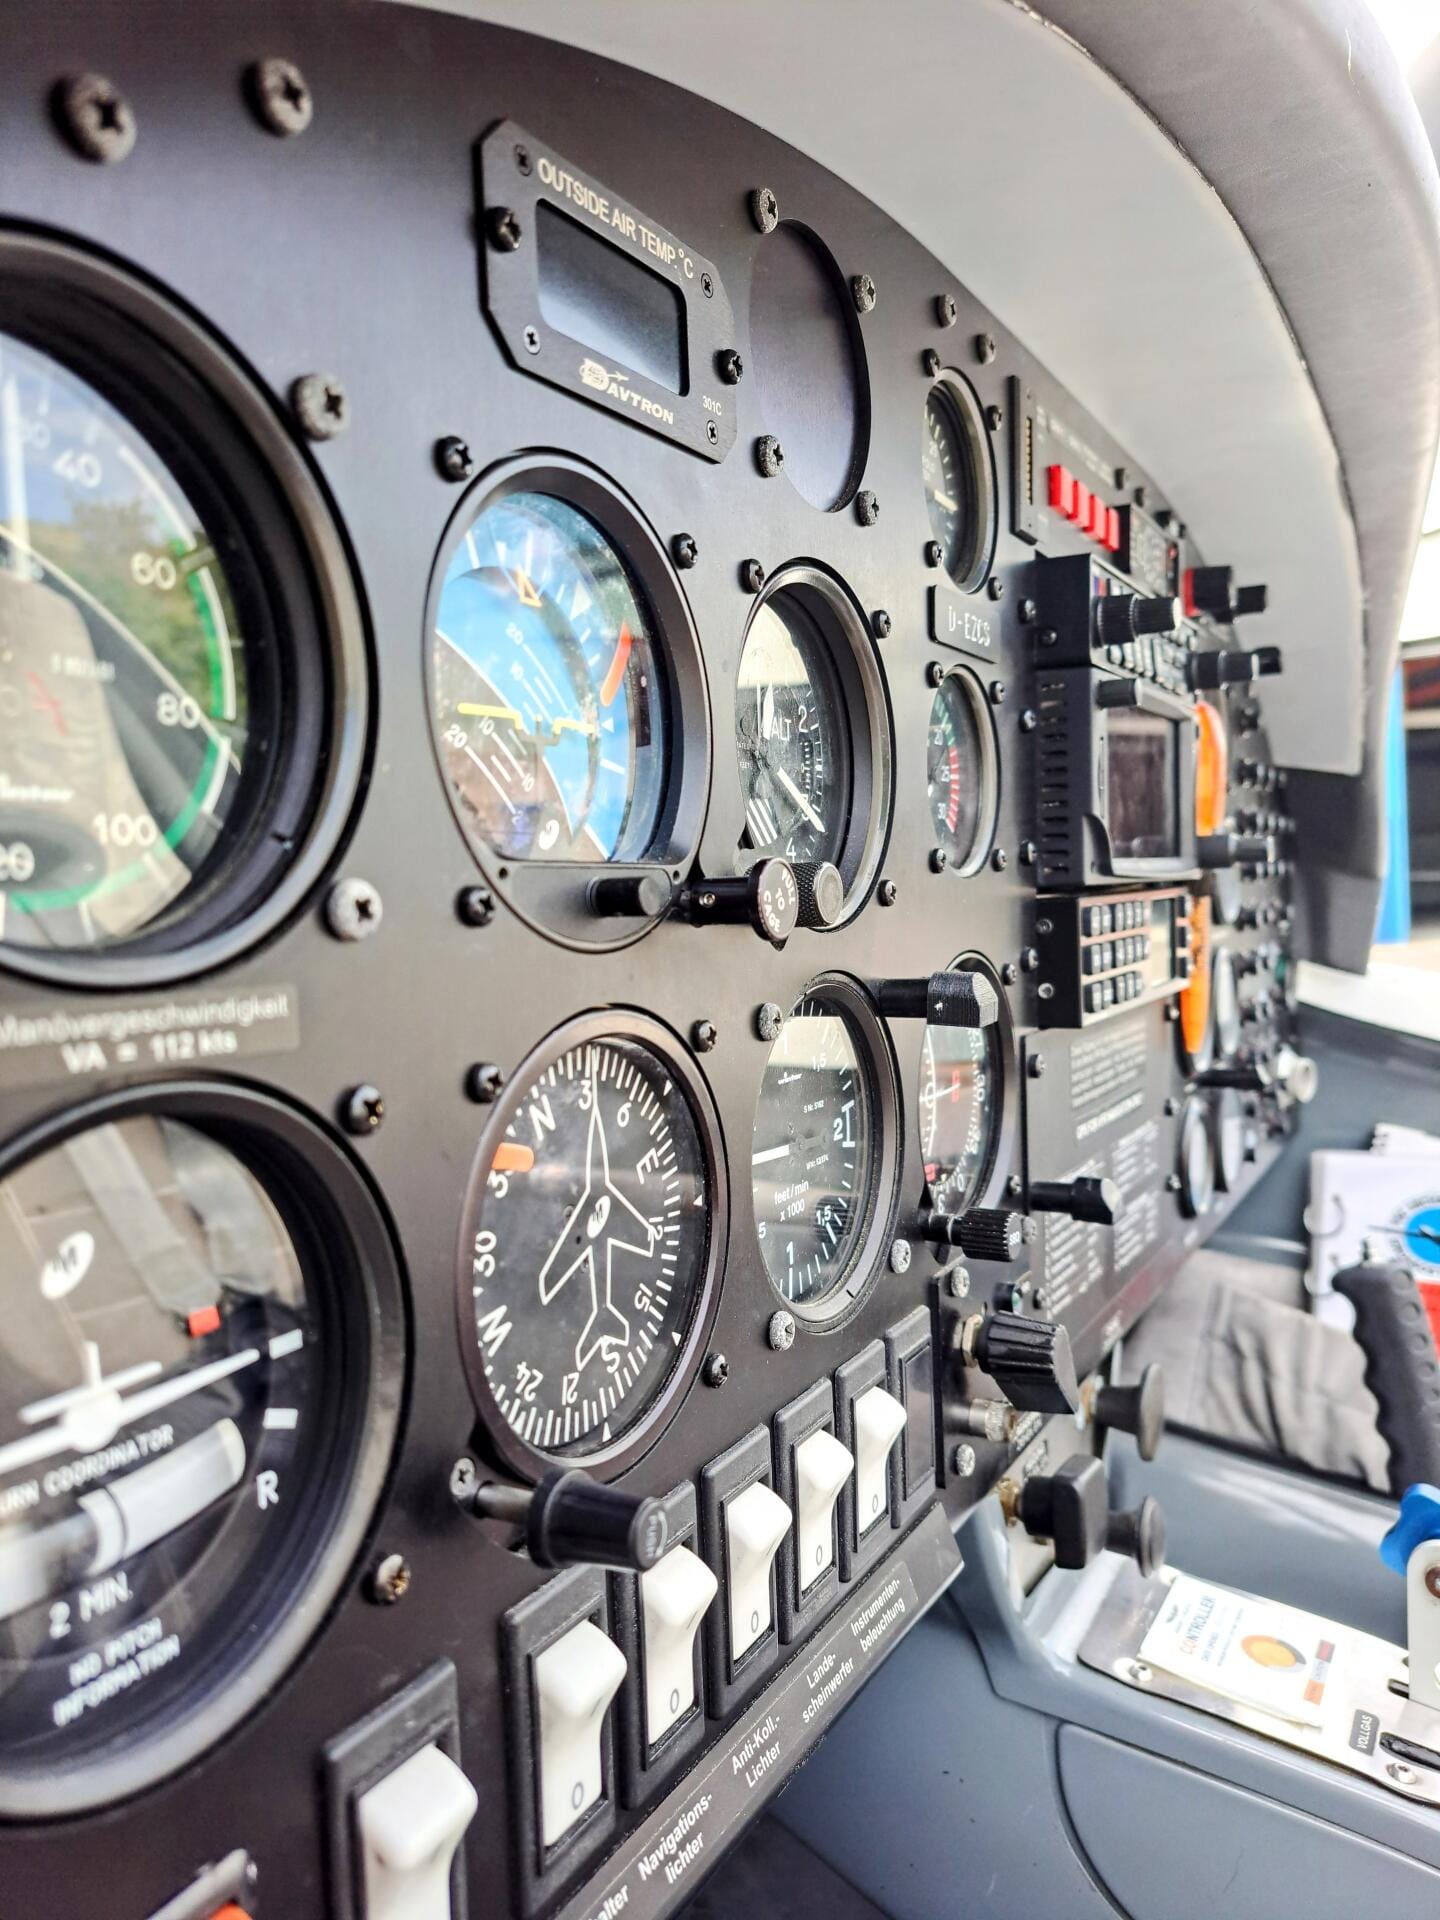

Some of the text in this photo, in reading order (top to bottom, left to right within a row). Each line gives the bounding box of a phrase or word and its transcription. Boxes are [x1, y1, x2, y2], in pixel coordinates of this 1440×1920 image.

[537, 158, 610, 224] OUTSIDE
[611, 208, 637, 242] AIR
[702, 395, 722, 416] 301C
[53, 449, 102, 488] 40
[131, 552, 176, 590] 60
[157, 692, 200, 729] 80
[479, 716, 494, 736] 10
[771, 716, 792, 741] ALT
[798, 705, 809, 733] 2
[444, 724, 469, 750] 20
[93, 812, 157, 847] 100
[786, 837, 797, 863] 4
[775, 887, 785, 911] TO
[781, 868, 795, 905] PULL
[764, 890, 780, 933] CAGE
[578, 1079, 592, 1110] 3
[529, 1094, 557, 1141] N
[617, 1101, 632, 1128] 6
[833, 1118, 844, 1141] 2
[636, 1147, 659, 1184] E
[774, 1180, 809, 1205] feet/min
[787, 1199, 805, 1218] 1000
[816, 1205, 831, 1226] 1,5
[473, 1230, 498, 1278] 30
[786, 1241, 794, 1264] 1
[477, 1304, 512, 1357] W
[515, 1361, 544, 1401] 24
[561, 1371, 580, 1405] 21
[44, 1424, 174, 1497] COORDINATOR
[256, 1470, 280, 1510] R
[49, 1601, 71, 1640] 2
[850, 1579, 900, 1636] Instrumenten-
[860, 1597, 905, 1652] beleuchtung
[806, 1653, 836, 1689] Lande-
[802, 1657, 855, 1724] scheinwerfer
[731, 1714, 781, 1775] Anti-Koll.-
[1357, 1714, 1374, 1750] VOLLGAS
[745, 1741, 781, 1788] Lichter
[637, 1792, 713, 1881] Navigations-
[665, 1832, 705, 1885] lichter
[588, 1885, 629, 1920] alter
